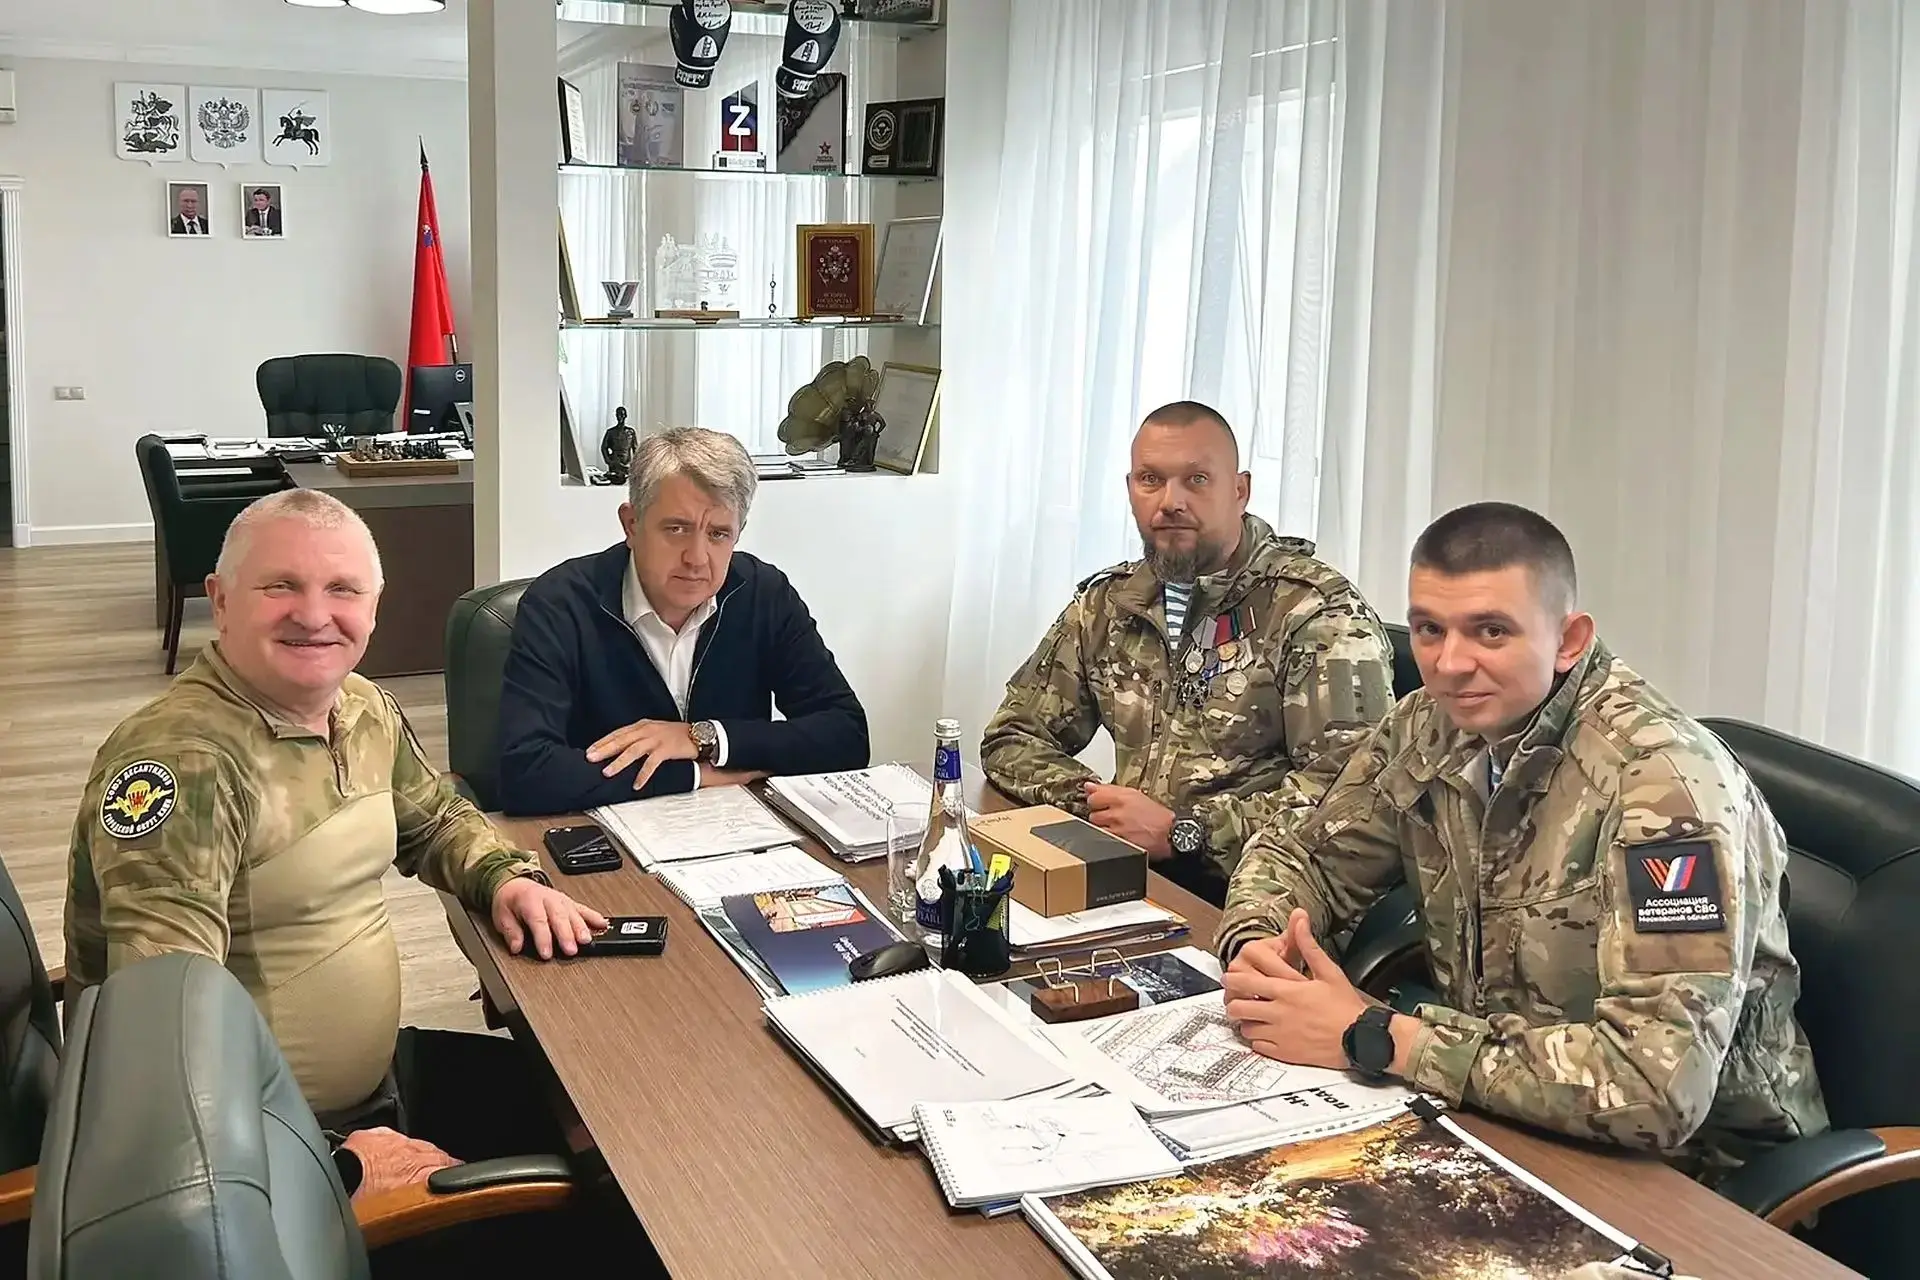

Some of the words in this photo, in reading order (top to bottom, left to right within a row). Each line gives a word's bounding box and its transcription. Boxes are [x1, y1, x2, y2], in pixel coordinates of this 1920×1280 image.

[728, 105, 751, 136] Z
[1645, 896, 1708, 907] Ассоциация
[1694, 903, 1718, 914] СВО
